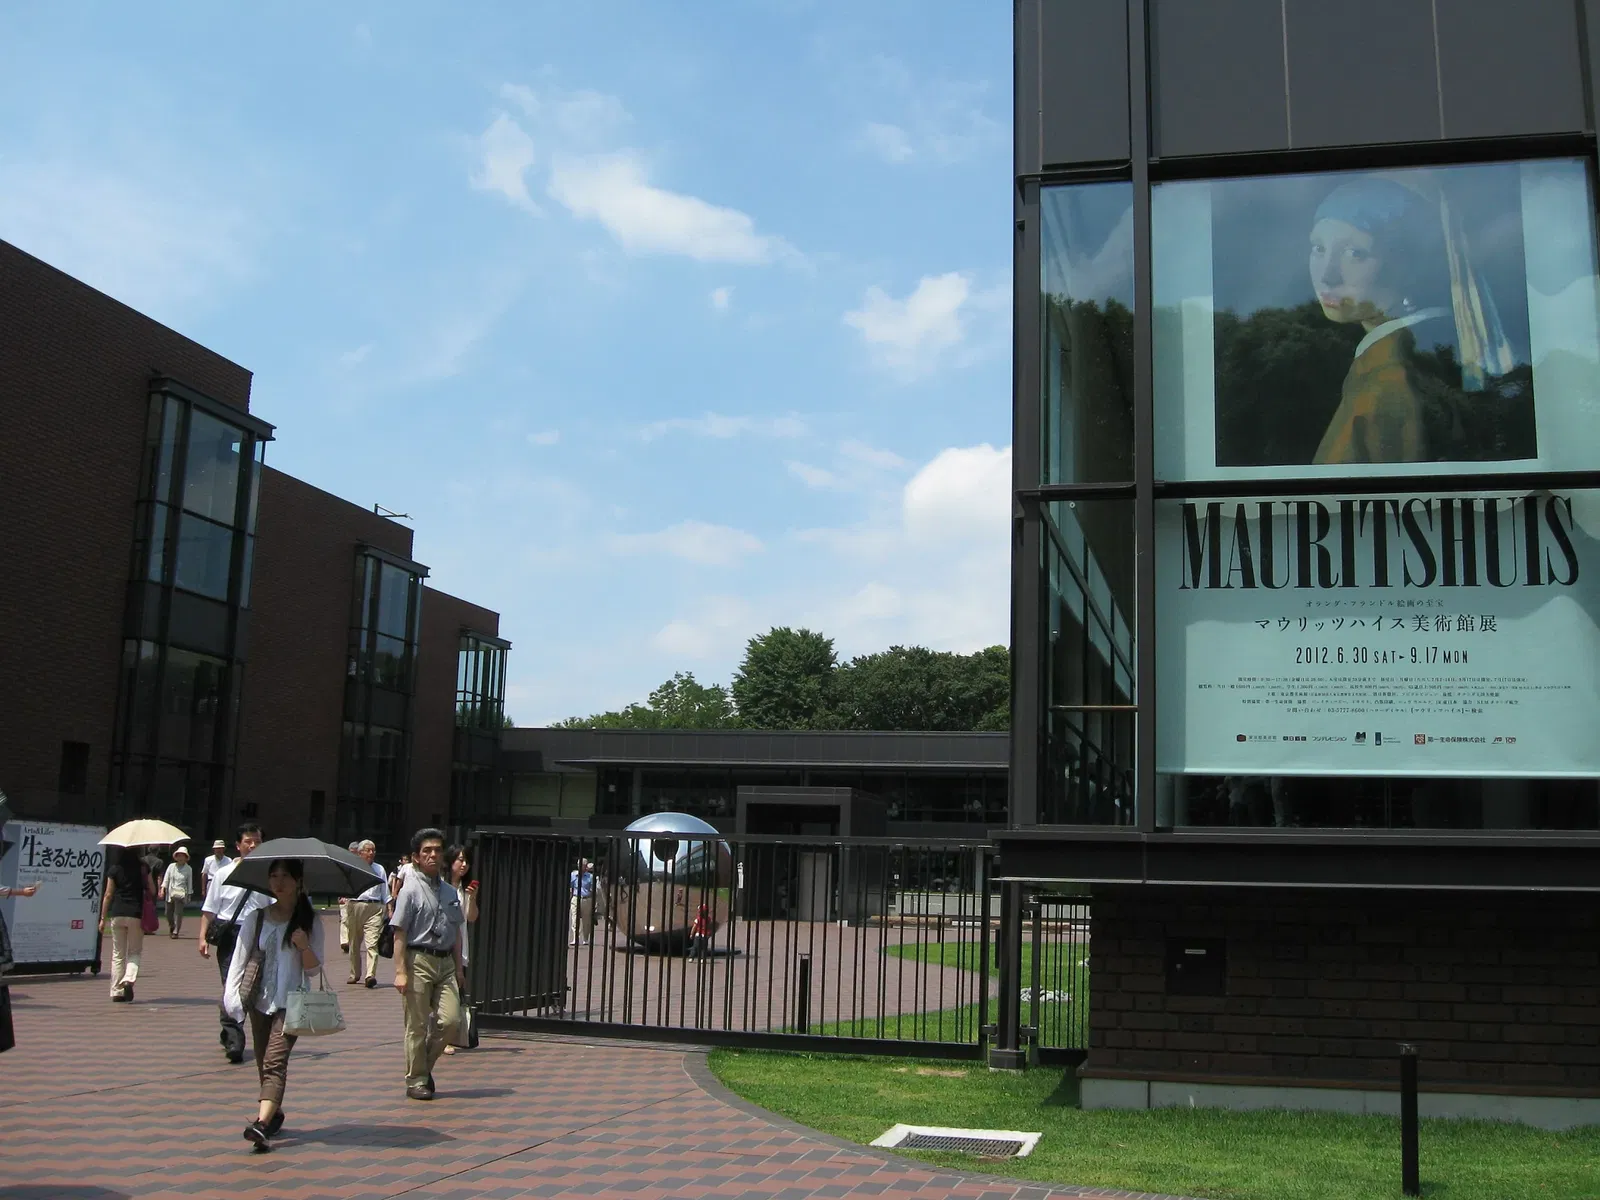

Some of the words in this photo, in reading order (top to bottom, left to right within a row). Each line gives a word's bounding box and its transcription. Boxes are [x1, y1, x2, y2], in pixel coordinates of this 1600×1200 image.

[1178, 495, 1579, 590] MAURITSHUIS
[1254, 613, 1498, 633] マウリッツハイス美術館展
[1295, 646, 1368, 665] 2012.6.30
[1374, 650, 1396, 664] SAT
[1410, 646, 1438, 665] 9.17
[1443, 649, 1468, 664] MON
[20, 835, 103, 869] 生きるための
